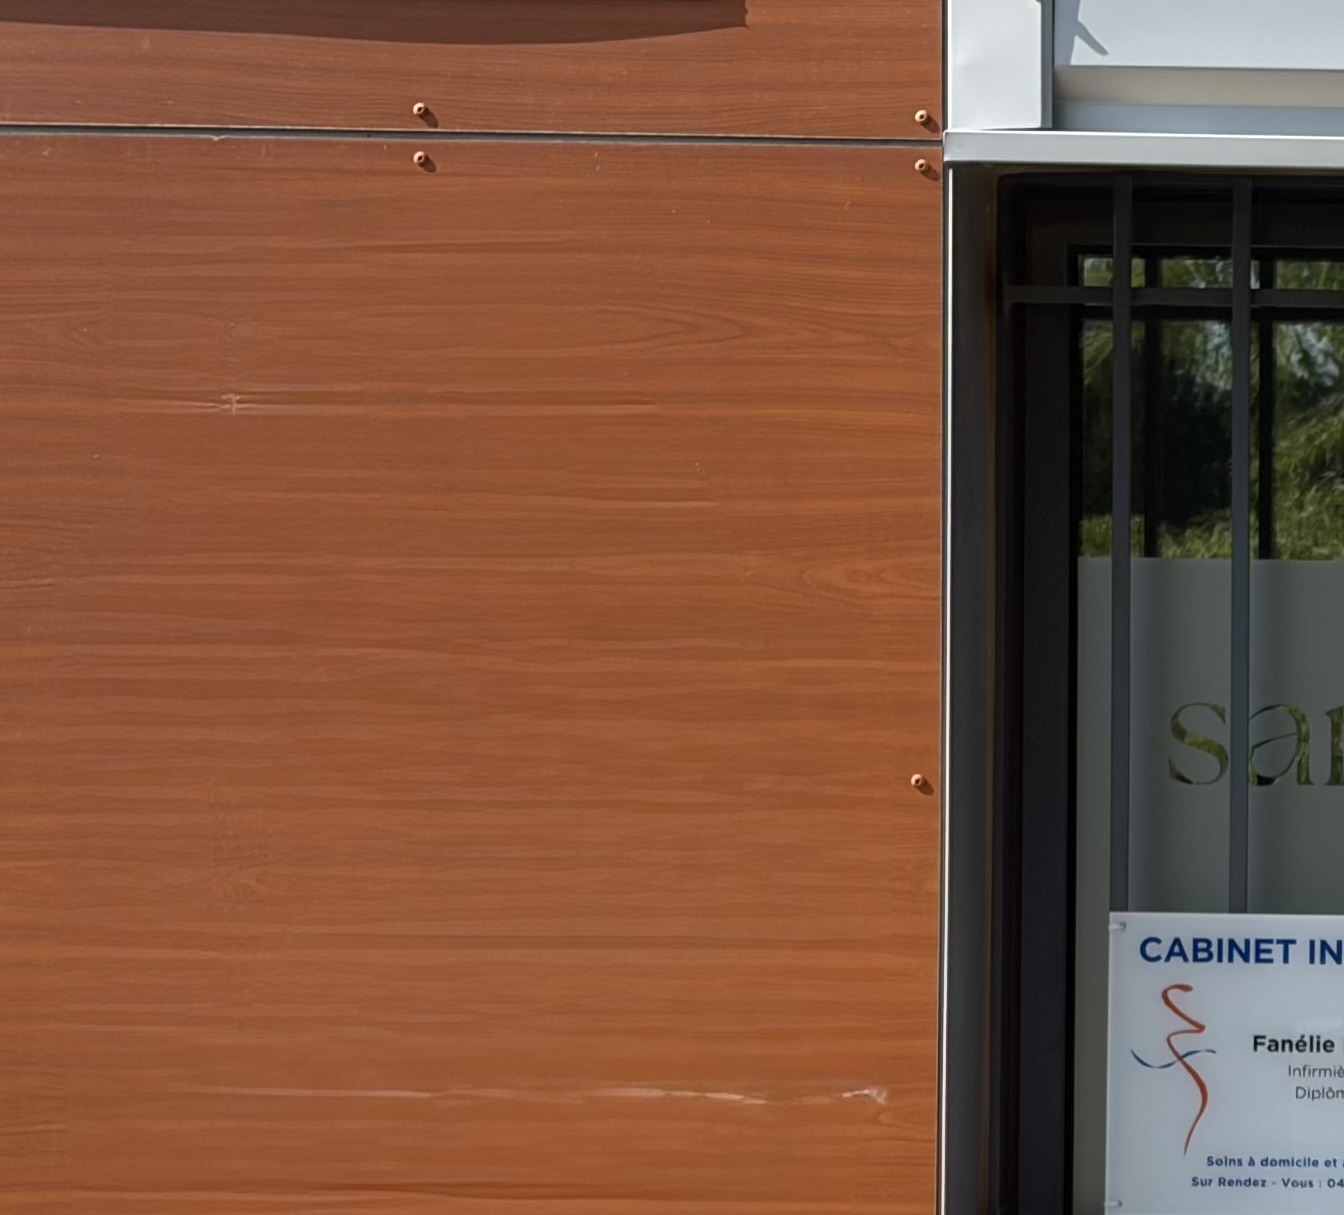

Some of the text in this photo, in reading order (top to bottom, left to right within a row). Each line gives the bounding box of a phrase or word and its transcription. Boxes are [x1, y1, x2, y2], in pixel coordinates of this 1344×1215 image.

[1139, 936, 1297, 965] CABINET
[1252, 1034, 1335, 1054] Fanélie
[1206, 1155, 1243, 1167] Soins
[1247, 1156, 1256, 1167] à
[1260, 1156, 1320, 1168] domicile
[1323, 1158, 1338, 1168] et
[1191, 1176, 1214, 1188] Sur
[1217, 1176, 1267, 1188] Rendez
[1280, 1177, 1314, 1189] Vous
